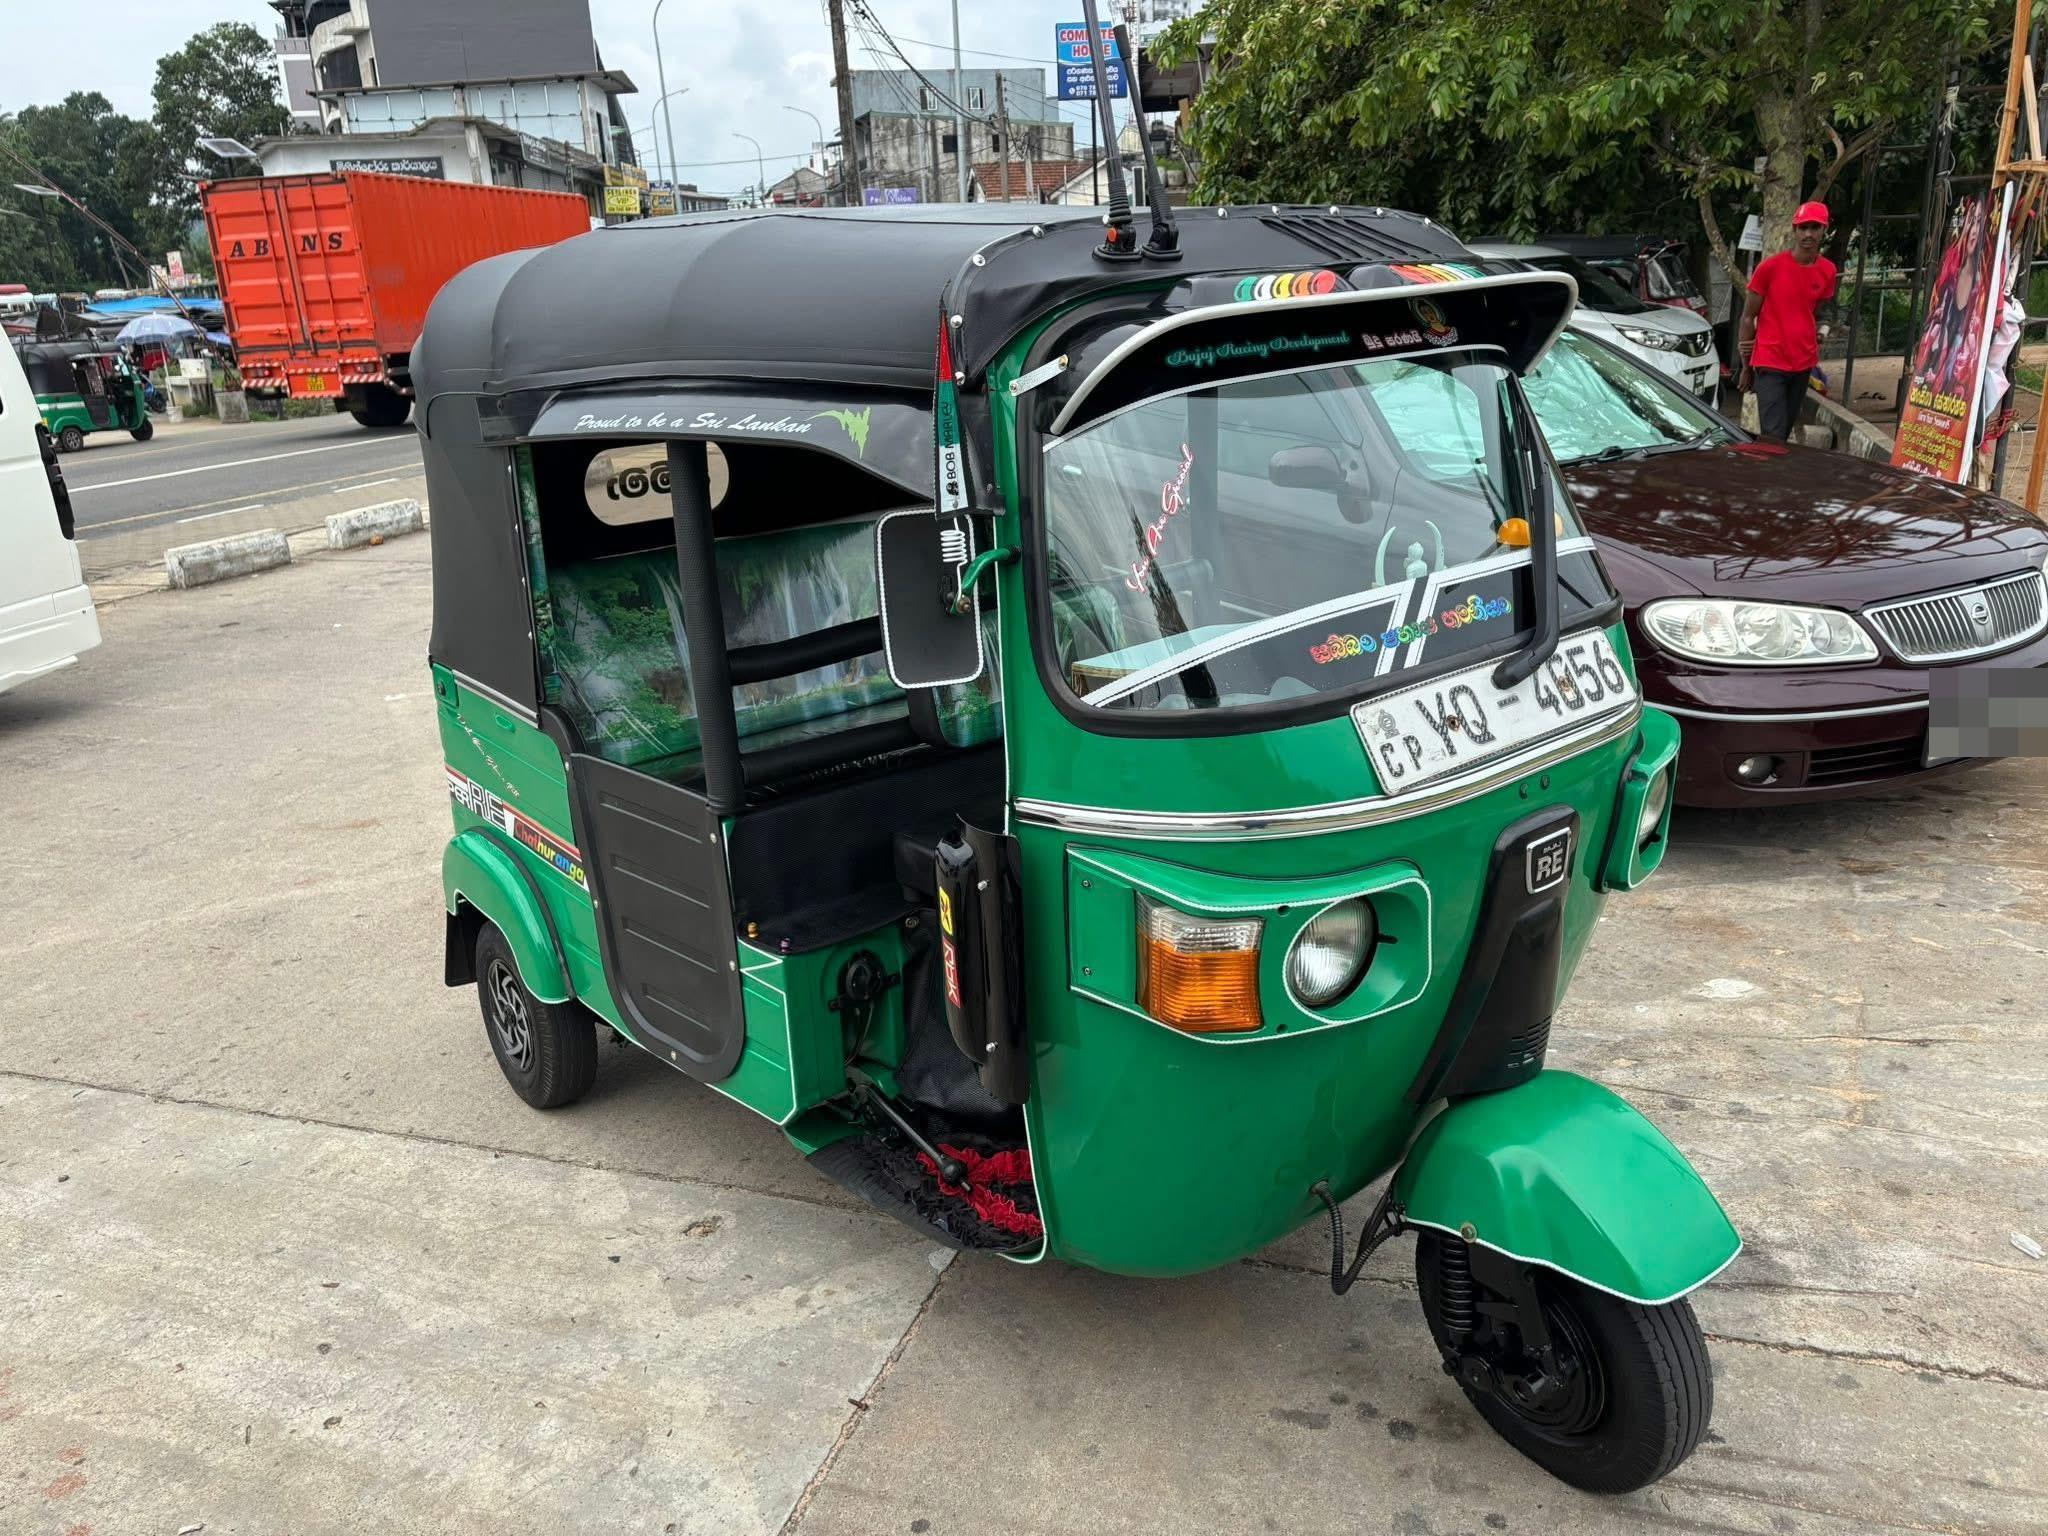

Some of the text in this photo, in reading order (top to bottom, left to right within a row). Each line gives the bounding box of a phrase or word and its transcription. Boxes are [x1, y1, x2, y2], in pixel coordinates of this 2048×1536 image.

[1216, 342, 1269, 358] Racing
[1269, 330, 1351, 351] Development
[574, 412, 812, 433] Proud to be a Sri Lankan
[941, 401, 957, 480] BOB MARLEY
[1162, 442, 1194, 515] Special
[515, 822, 585, 882] Chathuranga
[1536, 848, 1563, 882] RE
